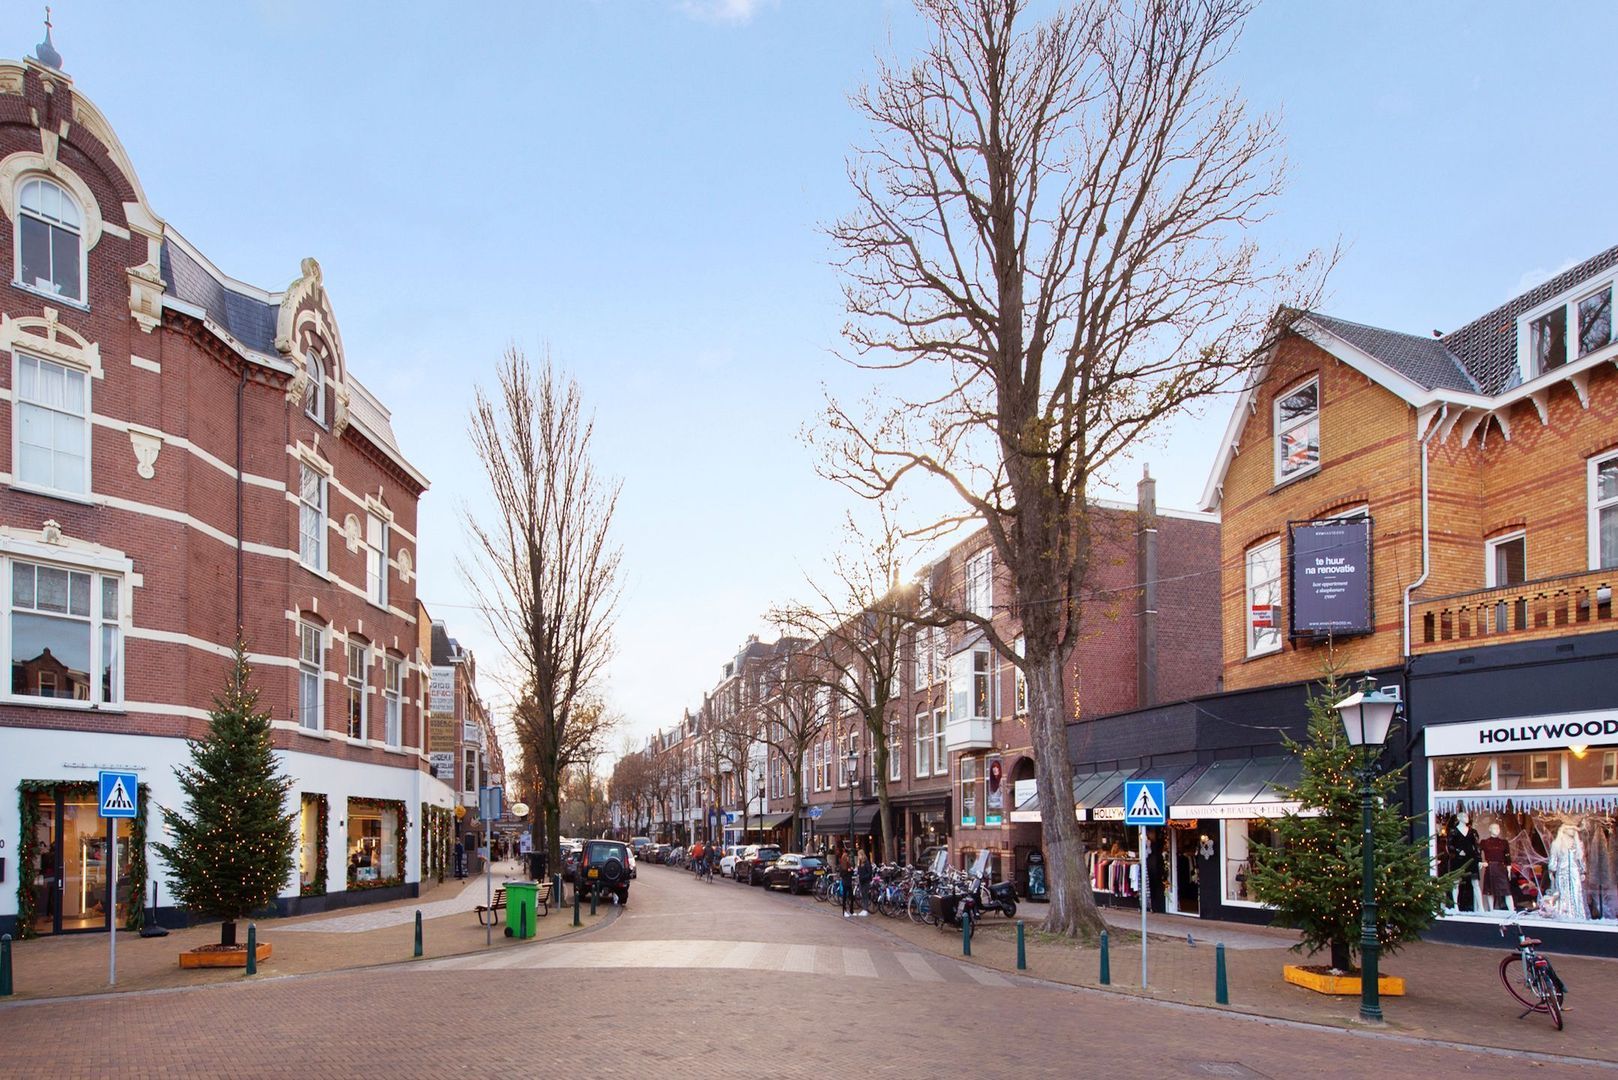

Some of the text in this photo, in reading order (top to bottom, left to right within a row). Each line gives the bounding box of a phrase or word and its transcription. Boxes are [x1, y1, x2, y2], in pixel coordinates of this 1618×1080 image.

[1315, 556, 1345, 566] te huur
[1305, 564, 1355, 575] na renovatie
[1479, 720, 1618, 744] HOLLYWOOD
[1093, 808, 1126, 819] HOLLYW
[1185, 806, 1217, 817] FASHION
[1226, 806, 1257, 815] BEAUTY
